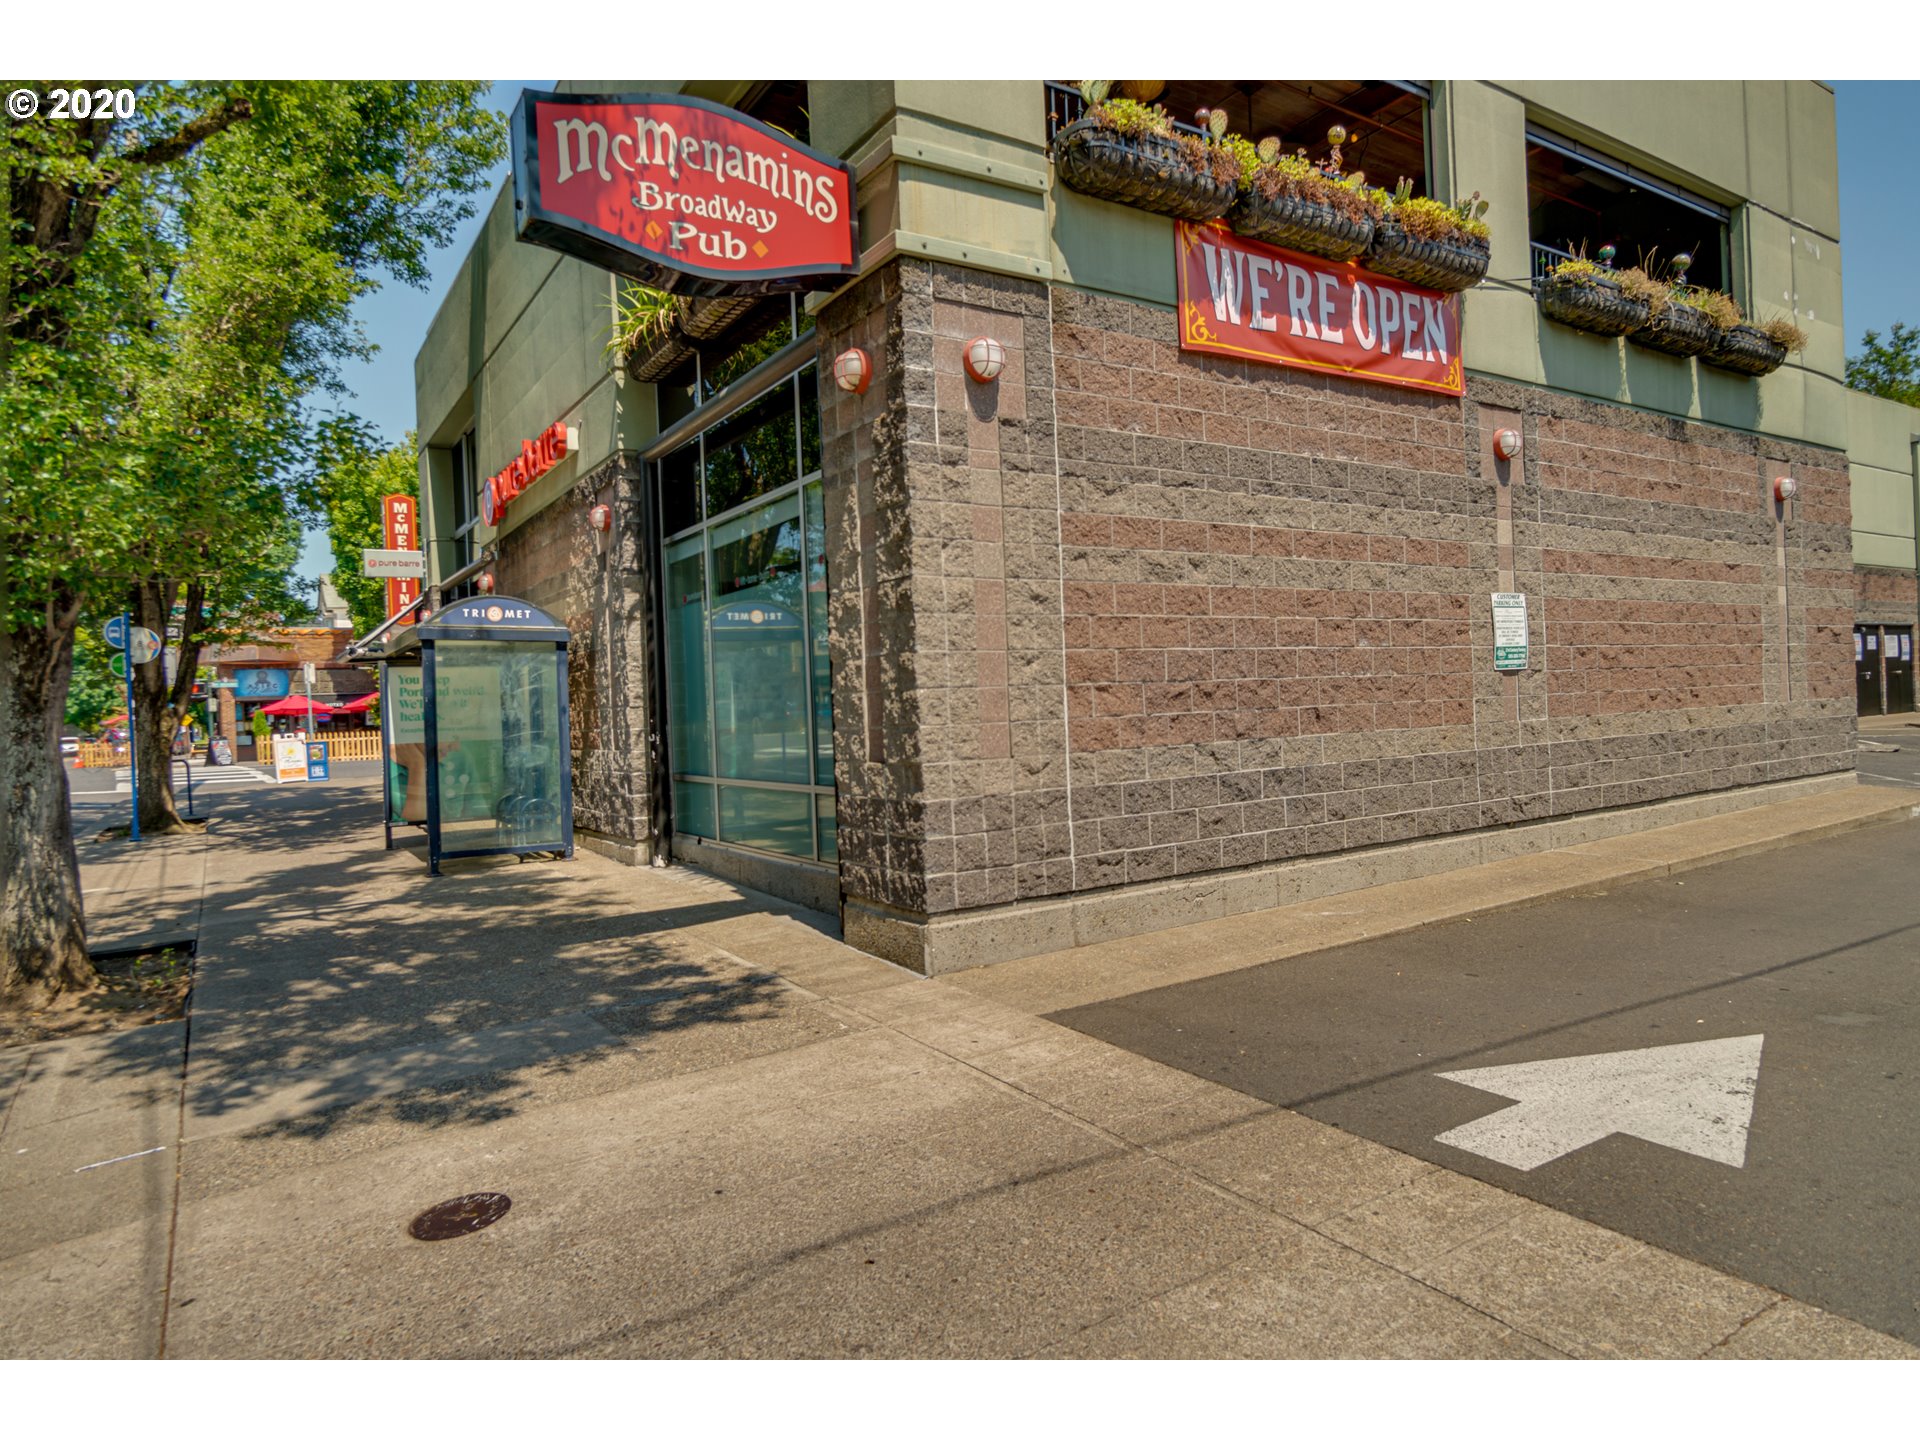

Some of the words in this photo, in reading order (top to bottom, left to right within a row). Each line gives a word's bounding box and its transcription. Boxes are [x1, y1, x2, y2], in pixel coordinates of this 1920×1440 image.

[553, 115, 838, 224] McMenamins
[668, 221, 748, 261] Pub
[1202, 242, 1344, 344] WE'RE
[1352, 281, 1448, 365] OPEN
[378, 559, 398, 568] pure
[398, 559, 420, 568] barre
[463, 608, 486, 619] TRI
[504, 609, 532, 620] MET
[398, 674, 420, 685] You
